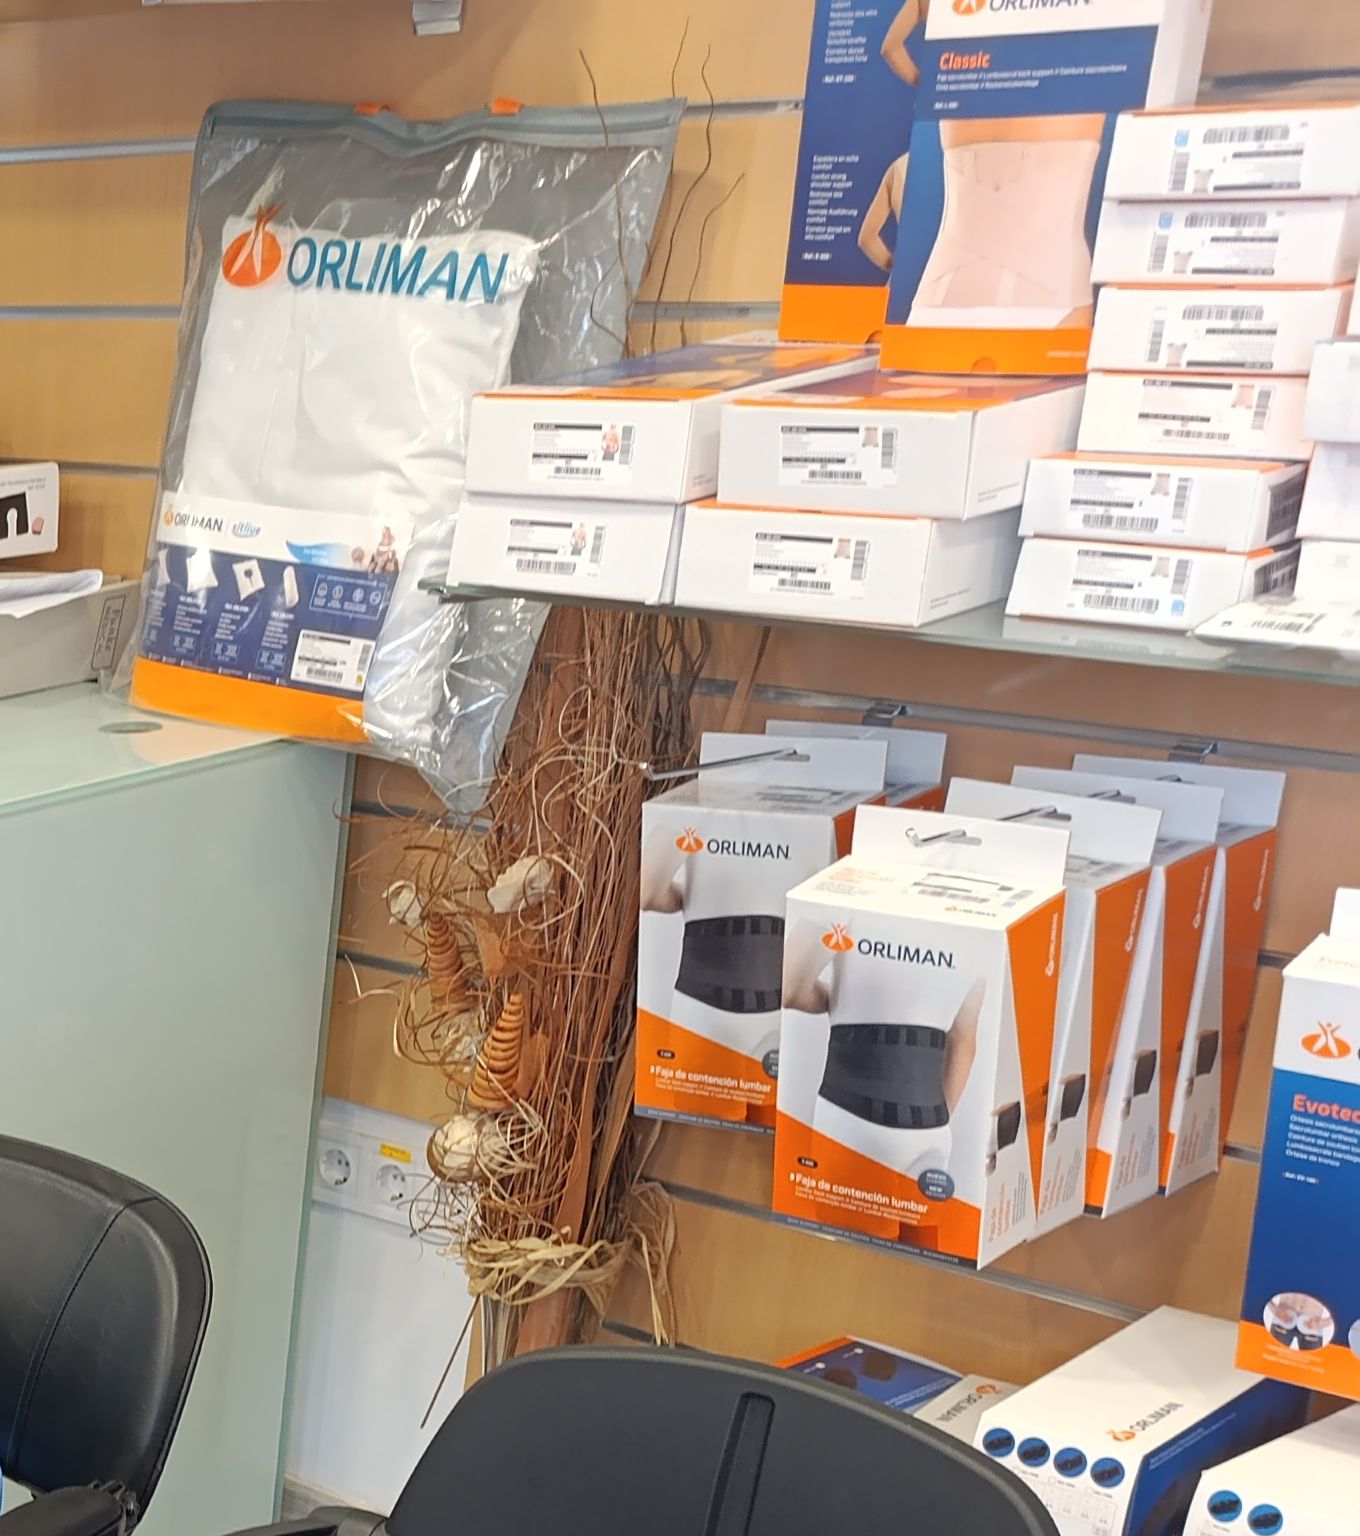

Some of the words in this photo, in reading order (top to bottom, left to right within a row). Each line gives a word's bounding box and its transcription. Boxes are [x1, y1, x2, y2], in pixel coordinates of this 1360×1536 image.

[939, 51, 991, 71] Classic
[286, 236, 510, 305] ORLIMAN
[707, 838, 790, 860] ORLIMAN
[858, 938, 954, 969] ORLIMAN
[655, 1066, 674, 1082] Faja
[674, 1069, 686, 1079] de
[687, 1070, 734, 1088] contención
[734, 1077, 772, 1094] lumbar
[795, 1172, 817, 1189] Faja
[817, 1179, 831, 1191] de
[832, 1180, 890, 1206] contención
[891, 1196, 929, 1215] lumbar
